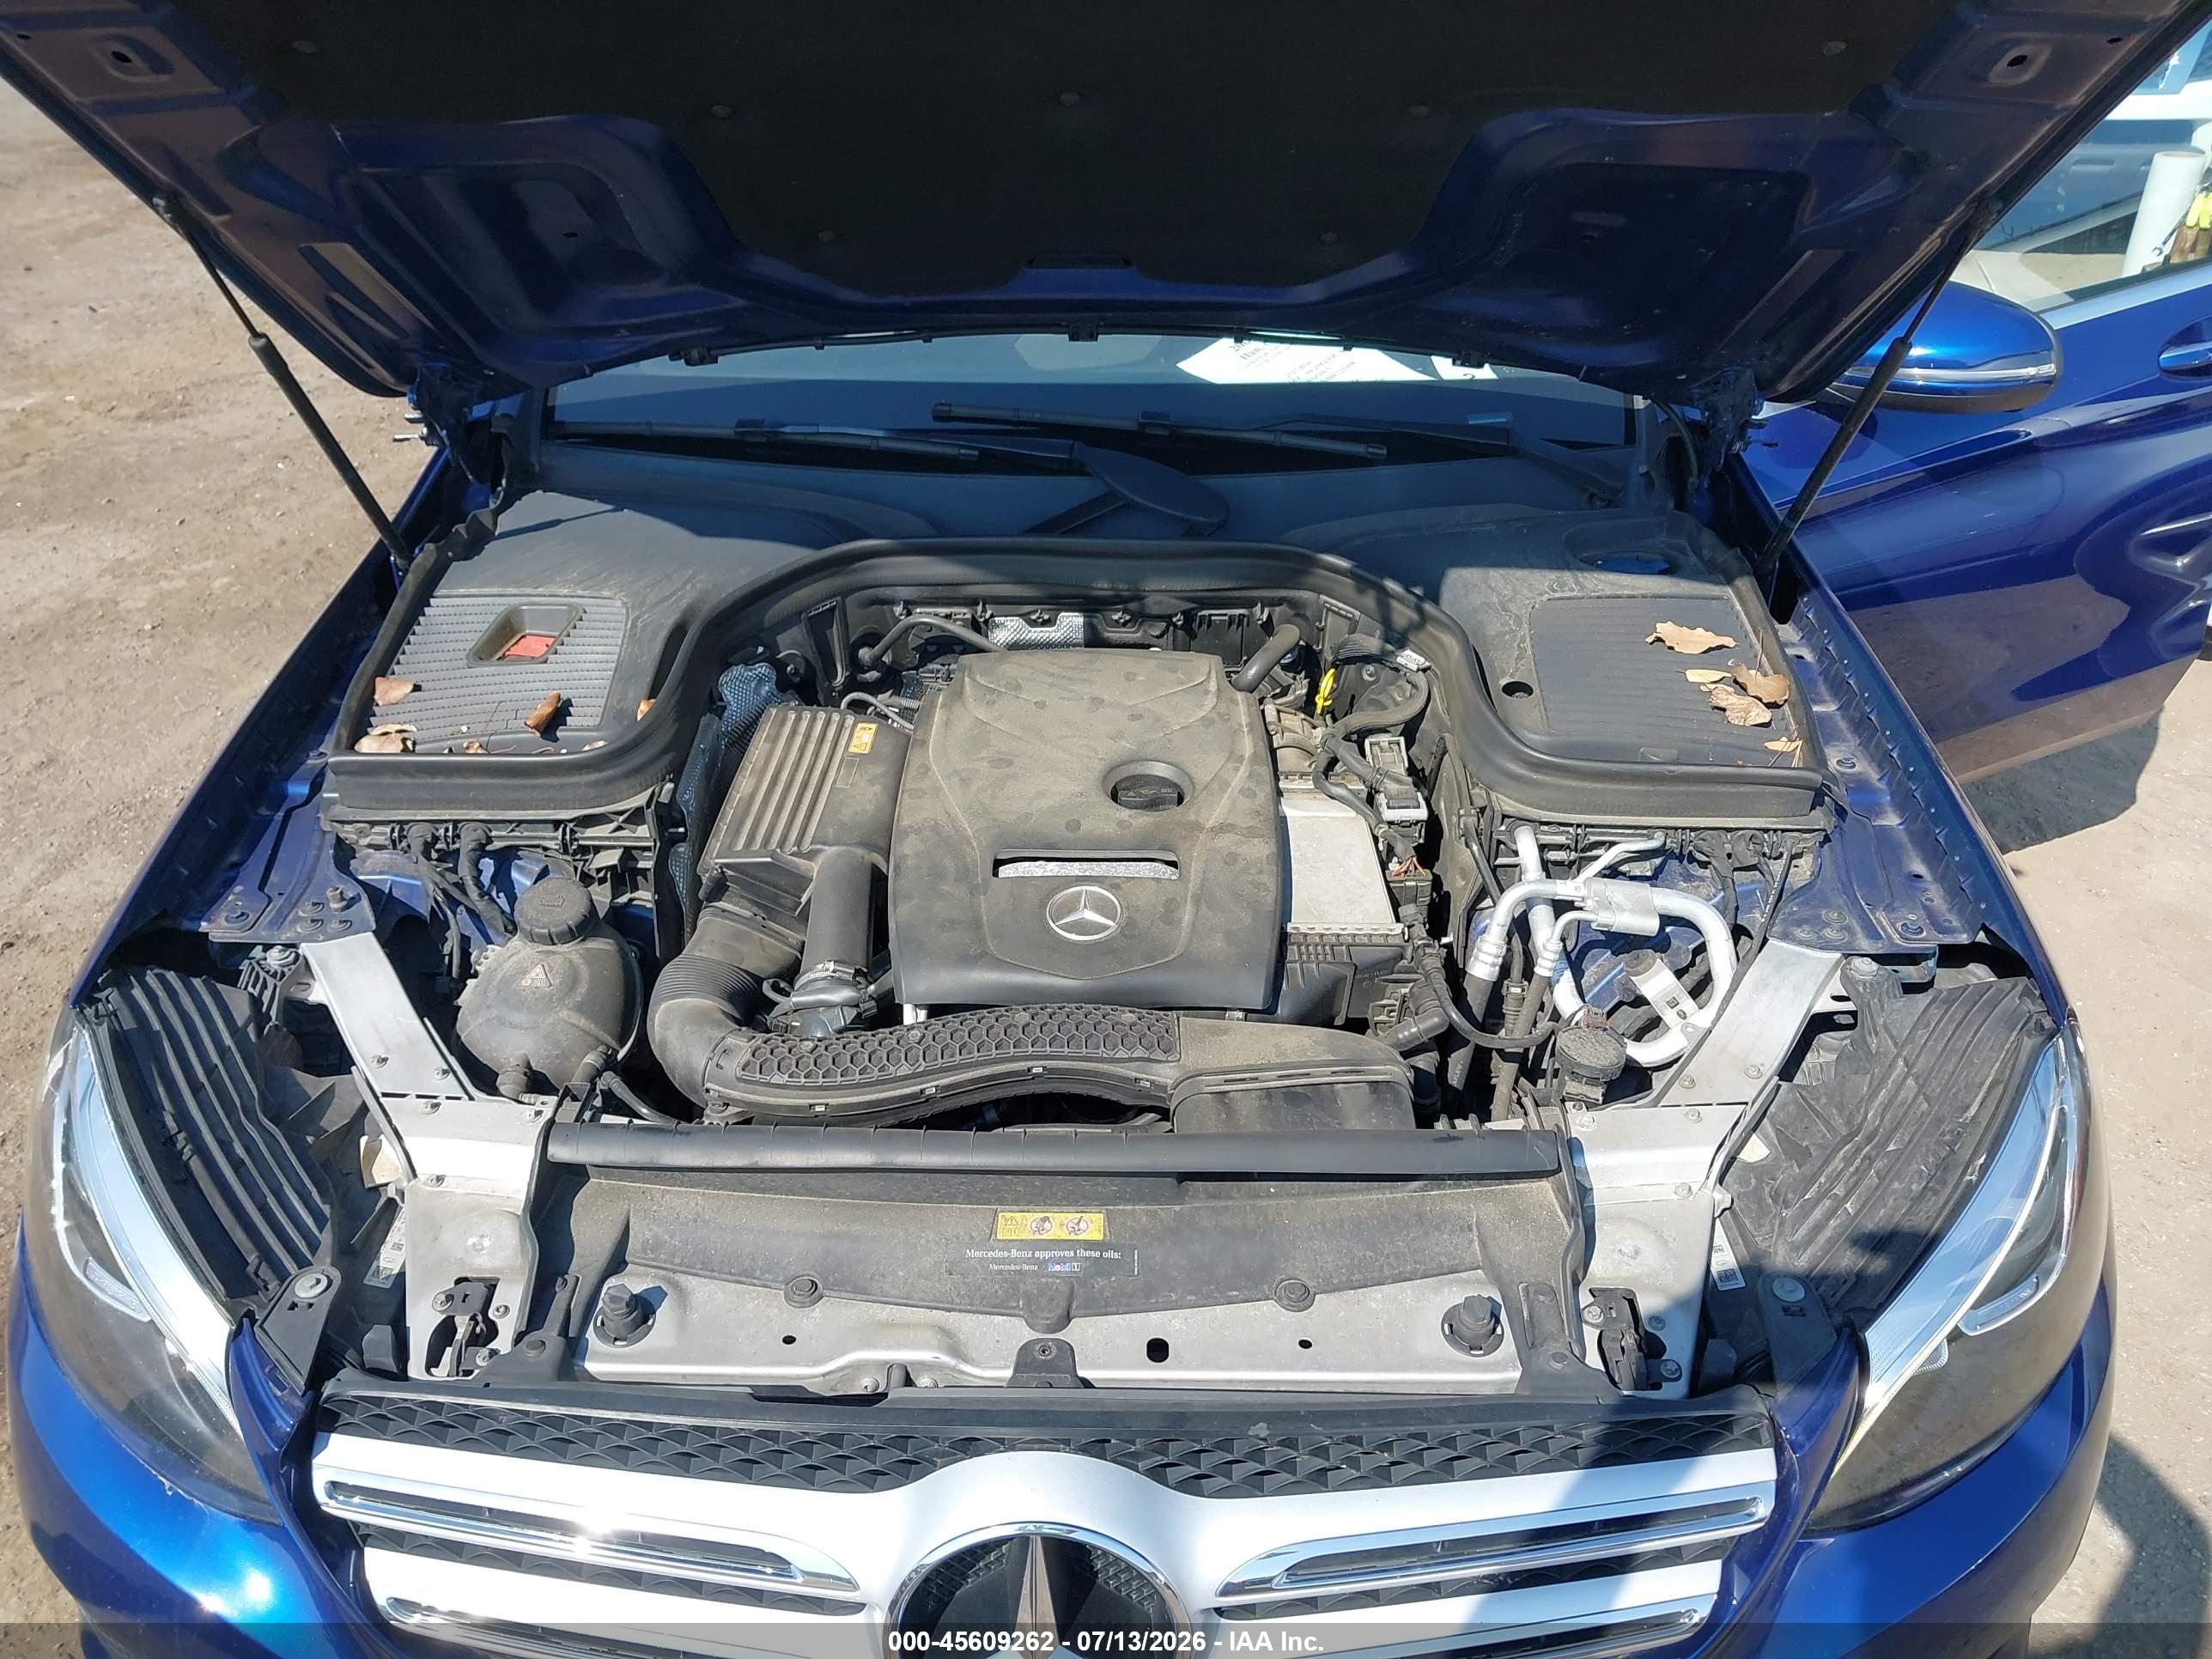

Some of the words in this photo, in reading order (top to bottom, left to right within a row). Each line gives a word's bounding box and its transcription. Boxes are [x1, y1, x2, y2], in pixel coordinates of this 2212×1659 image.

[965, 1249, 1032, 1258] Mercedes-Benz
[1034, 1249, 1074, 1260] approves
[1076, 1248, 1101, 1258] these
[1103, 1249, 1121, 1260] oils:
[1048, 1262, 1071, 1272] Mobil
